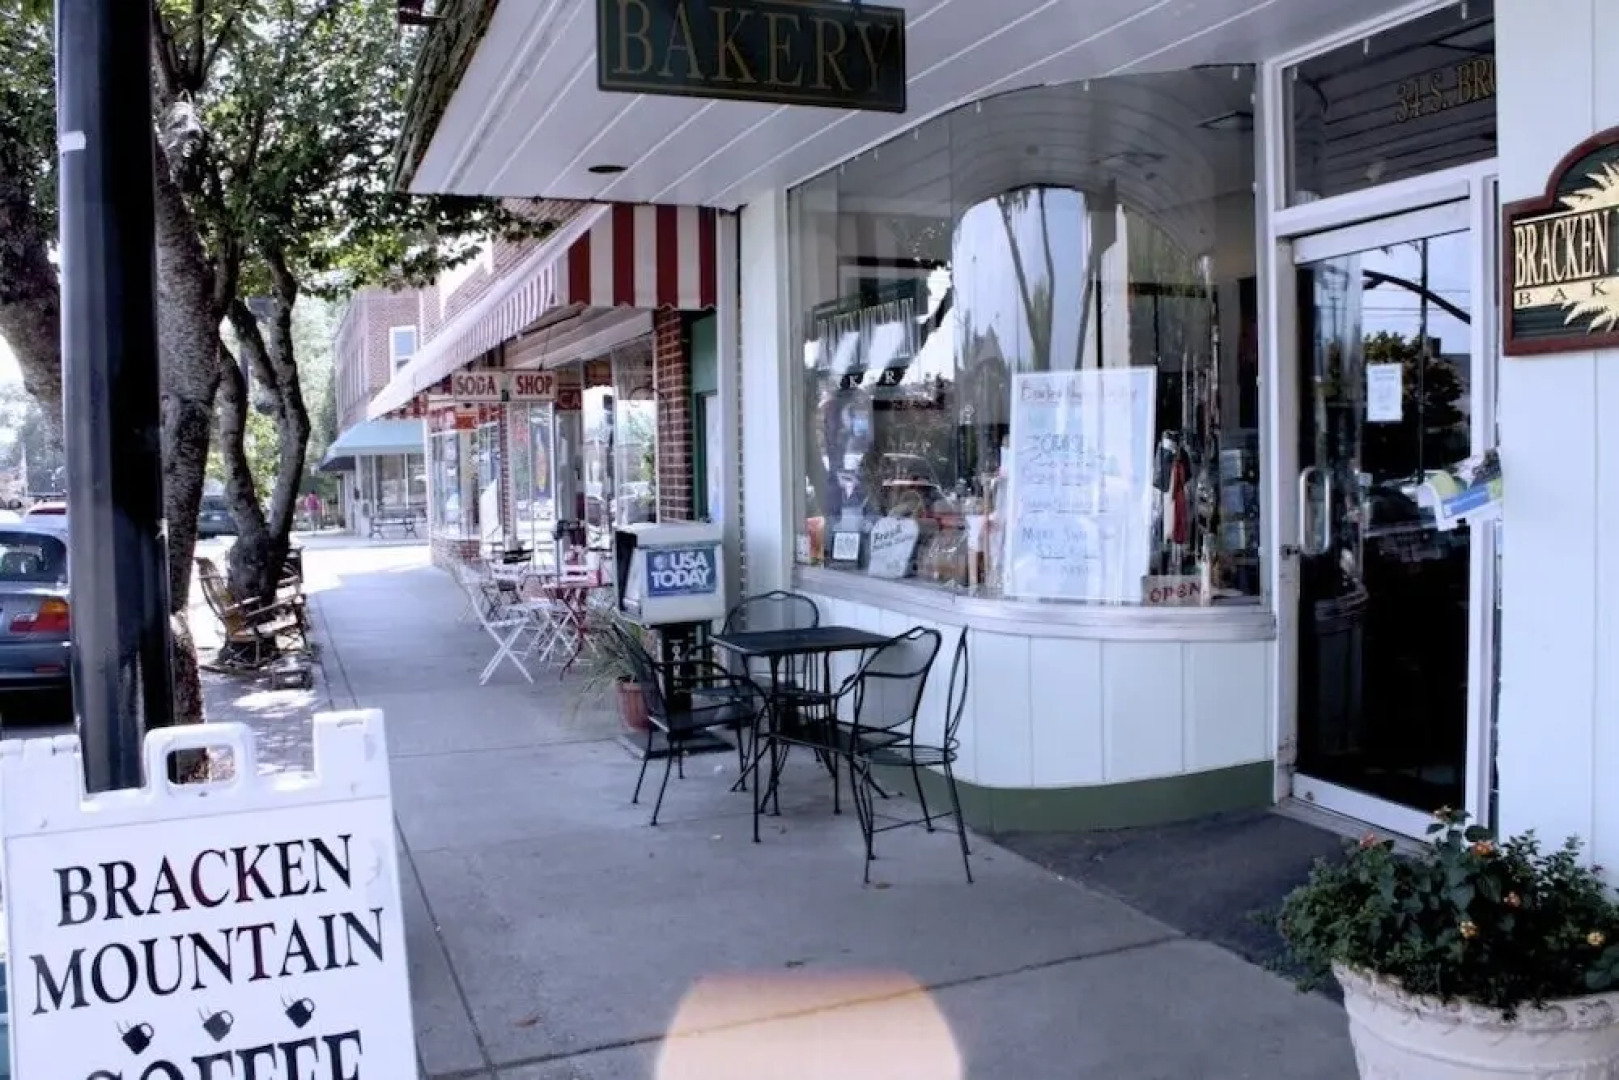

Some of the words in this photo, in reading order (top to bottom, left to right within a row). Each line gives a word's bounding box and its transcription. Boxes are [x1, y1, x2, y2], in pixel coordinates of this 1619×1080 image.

[613, 0, 894, 92] BAKERY
[1514, 211, 1609, 286] BRACKEN
[457, 376, 497, 395] SODA
[516, 376, 552, 395] SHOP
[651, 567, 711, 589] TODAY
[670, 551, 707, 569] USA
[54, 834, 353, 926] BRACKEN
[30, 908, 384, 1014] MOUNTAIN
